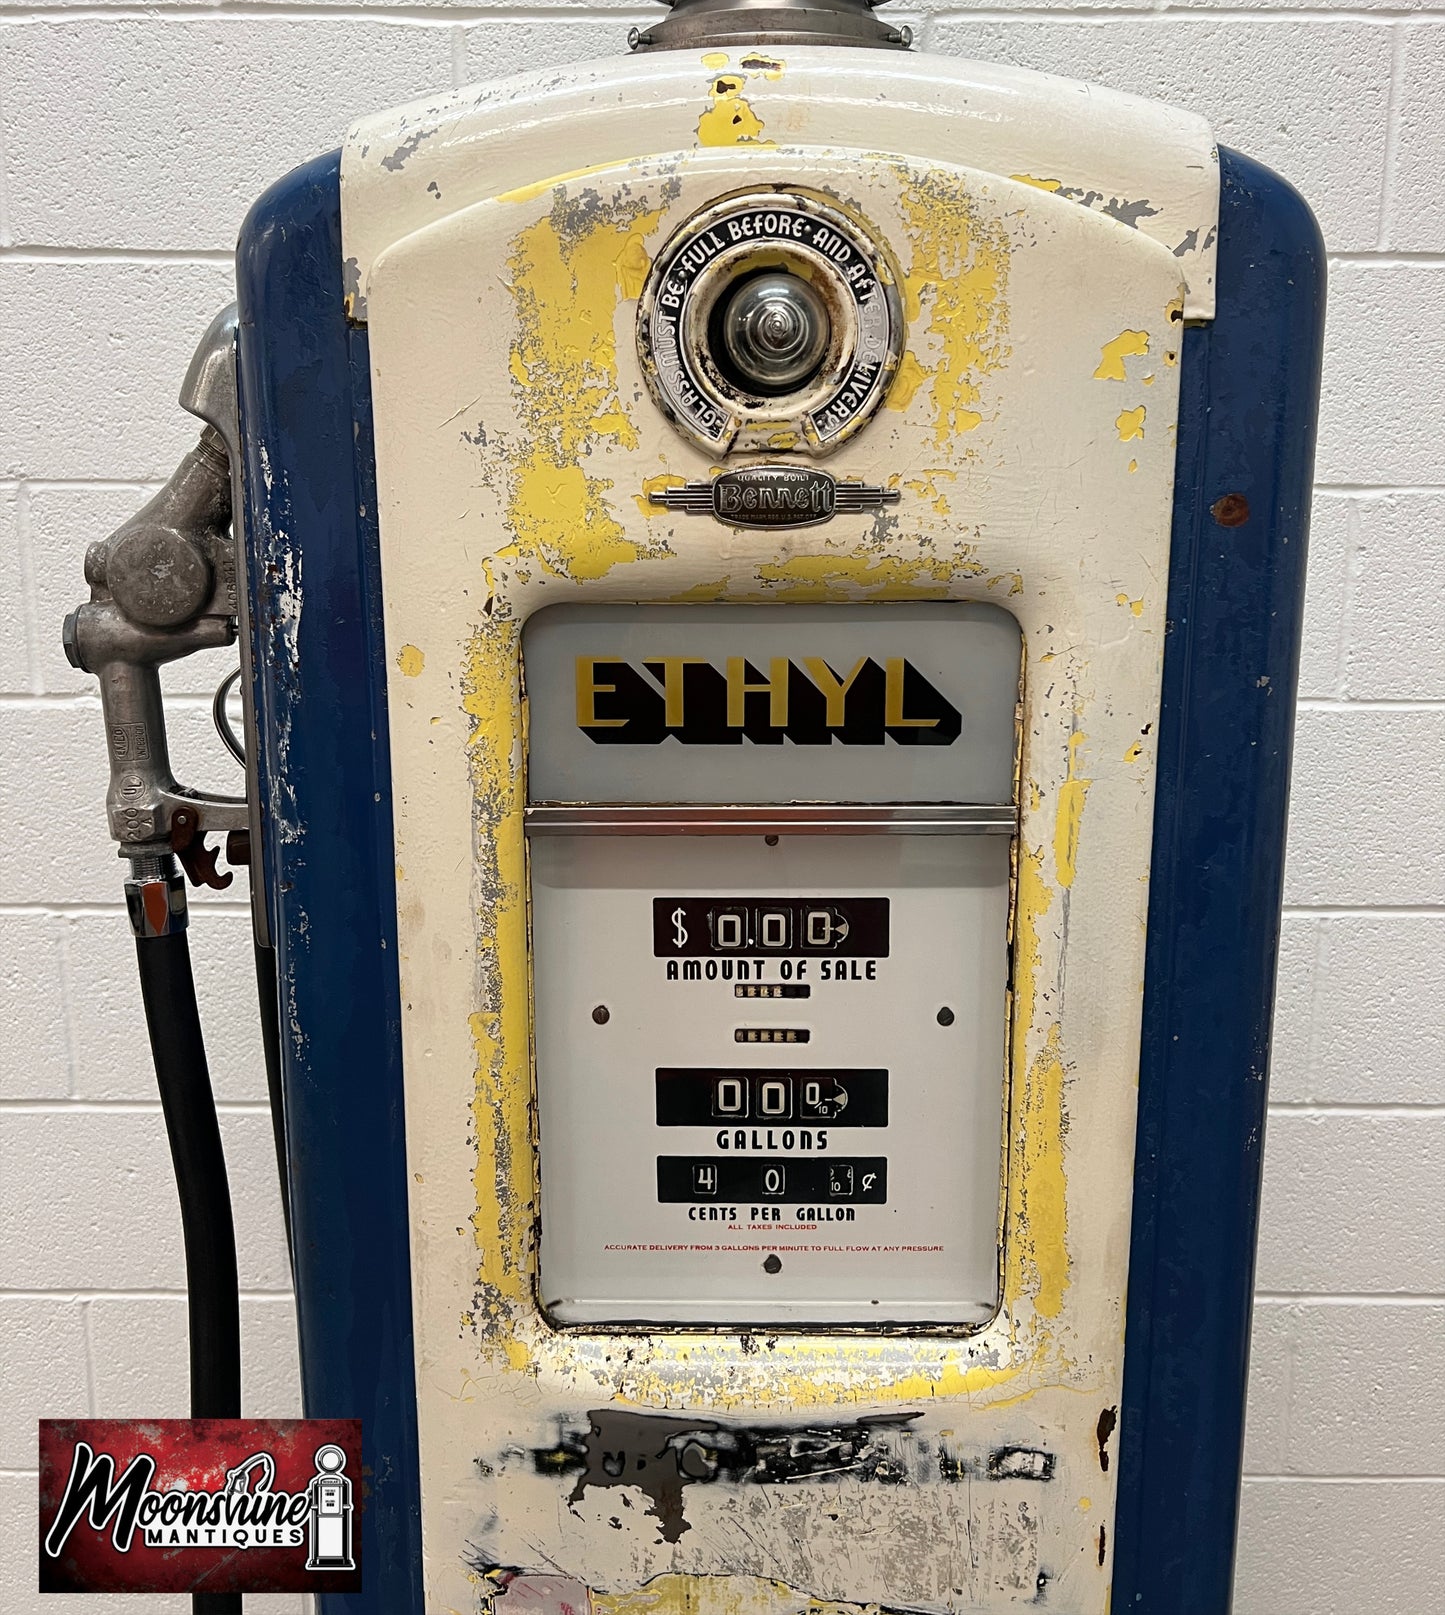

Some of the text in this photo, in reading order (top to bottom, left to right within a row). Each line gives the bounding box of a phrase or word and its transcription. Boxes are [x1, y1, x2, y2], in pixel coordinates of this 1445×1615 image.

[656, 214, 882, 430] GLASS MUST BE FULL BEFORE AND AFTER DELIVERY
[737, 473, 809, 482] QUALITY BUILT
[718, 481, 832, 513] Bennett
[576, 656, 962, 745] ETHYL
[666, 960, 877, 980] AMOUNT OF SALE
[716, 1130, 828, 1150] GALLONS
[688, 1207, 855, 1221] CENTS PER GALLON
